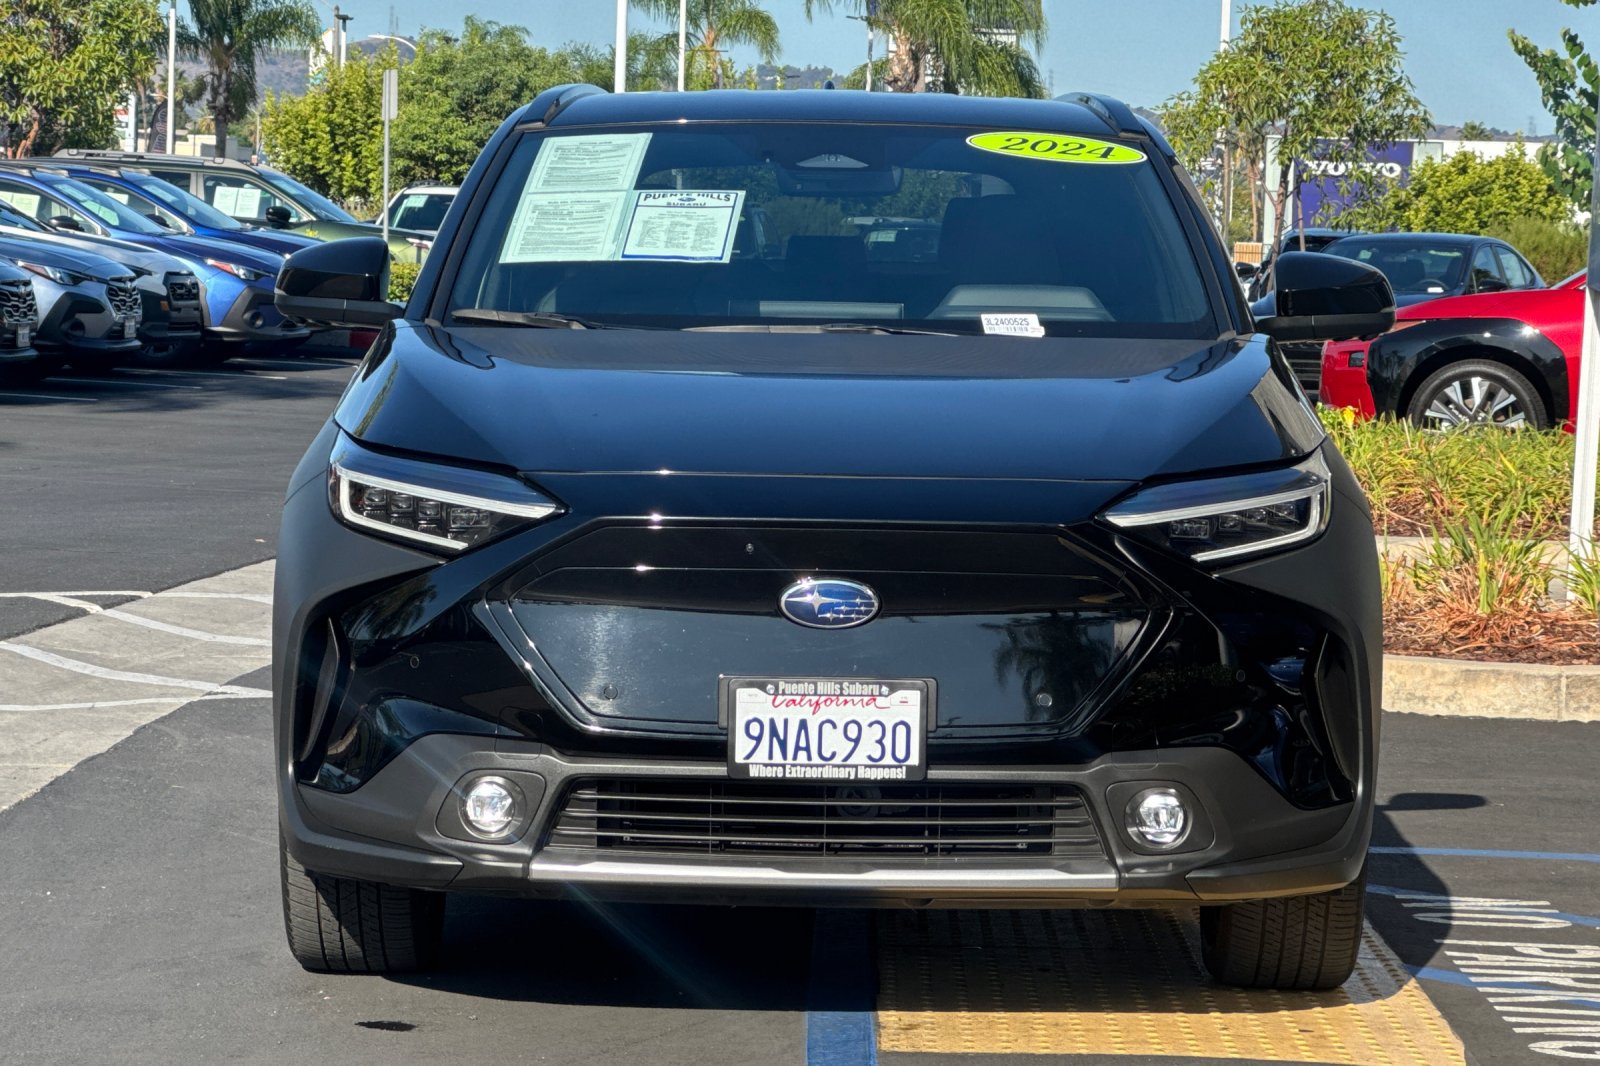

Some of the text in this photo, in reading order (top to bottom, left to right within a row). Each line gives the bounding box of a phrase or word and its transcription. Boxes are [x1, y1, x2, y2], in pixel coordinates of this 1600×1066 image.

[1000, 137, 1115, 159] 2024
[643, 193, 732, 202] PUENTE HILLS
[984, 317, 1030, 326] 3L2400525
[778, 681, 880, 696] Puente Hills Subaru
[771, 694, 891, 715] California
[743, 717, 912, 763] 9NAC930
[749, 764, 906, 780] Where Extraordinary Happens!
